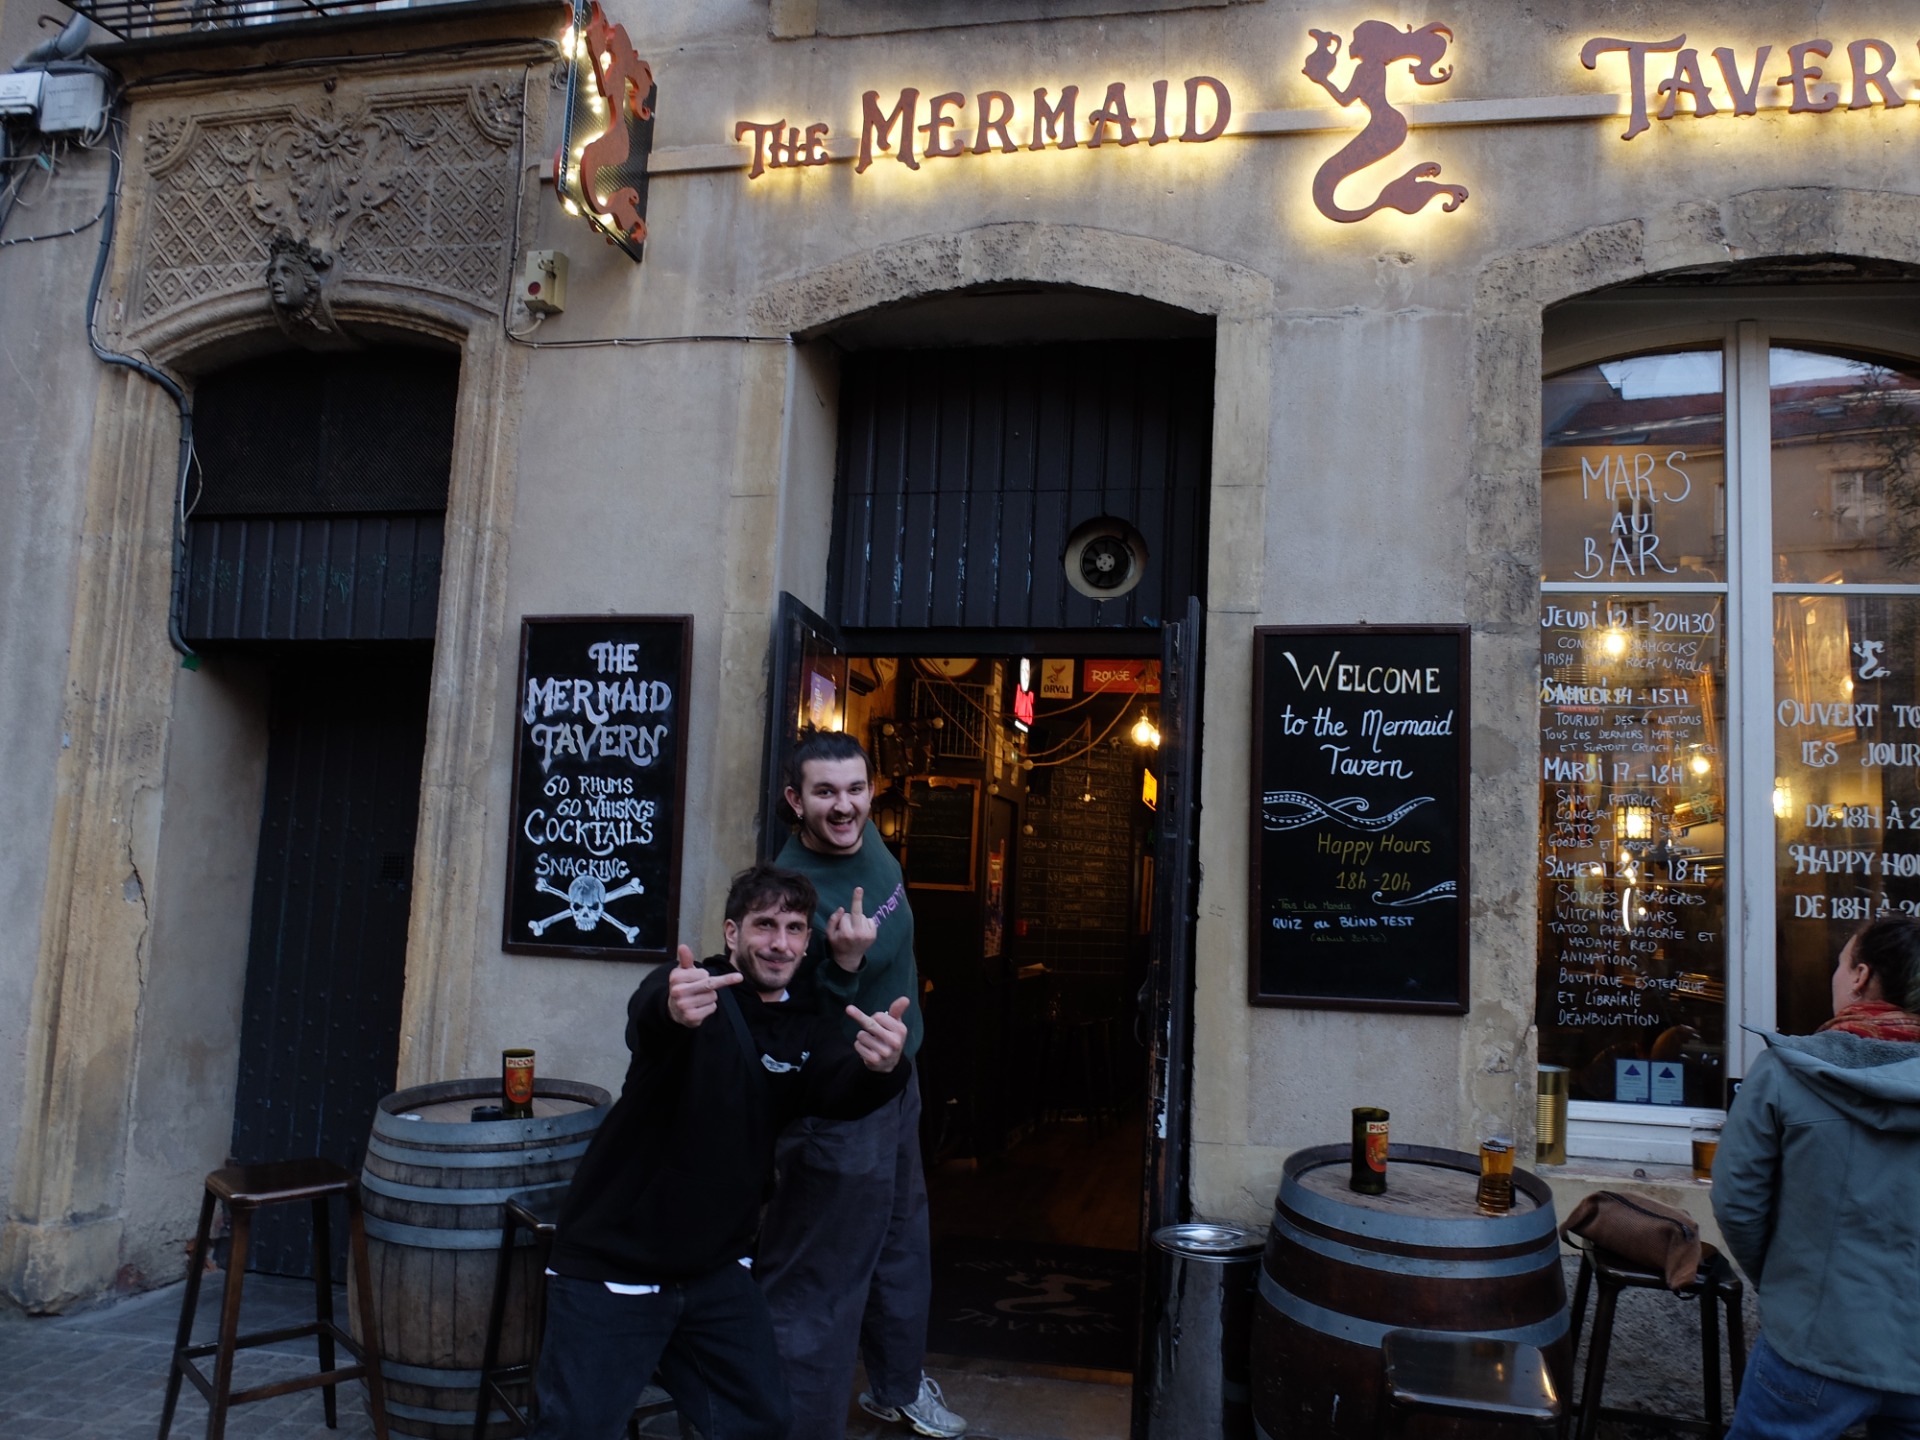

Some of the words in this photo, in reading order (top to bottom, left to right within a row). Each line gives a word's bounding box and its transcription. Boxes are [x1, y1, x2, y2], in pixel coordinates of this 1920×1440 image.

[735, 118, 829, 179] THE
[855, 75, 1232, 174] MERMAID
[1580, 33, 1920, 140] TAVER
[1581, 451, 1691, 503] MARS
[1610, 512, 1649, 535] AU
[1574, 534, 1678, 579] BAR
[1651, 611, 1716, 634] 20H30
[588, 640, 639, 675] THE
[1091, 669, 1131, 682] ROUGE
[1283, 651, 1441, 695] WELCOME
[524, 677, 672, 725] MERMAID
[1043, 684, 1070, 694] ORVAL
[1652, 688, 1689, 706] 15H
[1614, 714, 1635, 727] DES
[1641, 710, 1652, 726] 6
[1777, 699, 1879, 728] OUVERT
[1281, 704, 1308, 736] to
[1312, 707, 1348, 737] the
[1361, 709, 1454, 753] Mermaid
[531, 723, 668, 774] TAVERN
[1559, 743, 1577, 753] ET
[1801, 740, 1839, 768] LES
[1320, 744, 1413, 779] Tavern
[1613, 763, 1630, 783] 17
[1652, 764, 1684, 784] 18H
[543, 775, 569, 797] 60
[579, 775, 633, 799] RHUMS
[556, 798, 581, 817] 60
[585, 795, 655, 823] WHISKYS
[1556, 804, 1614, 820] CONCERT
[1608, 794, 1662, 808] PATRICK
[1805, 803, 1838, 828] DE
[1842, 805, 1881, 829] 18H
[1886, 800, 1905, 829] À
[524, 808, 653, 856] COCKTAILS
[1554, 822, 1601, 835] TATOO
[1317, 832, 1372, 865] Happy
[1379, 834, 1431, 855] Hours
[1788, 844, 1876, 876] HAPPY
[1881, 852, 1920, 877] HO
[535, 853, 629, 882] SNACKING
[1335, 871, 1367, 890] 18h
[1794, 894, 1828, 918] DE
[1831, 897, 1871, 920] 18H
[1380, 916, 1415, 927] TEST
[1547, 921, 1589, 934] TATOO
[1698, 931, 1717, 943] ET
[1568, 937, 1622, 951] MADAME
[1630, 939, 1658, 953] RED
[1557, 991, 1576, 1004] ET
